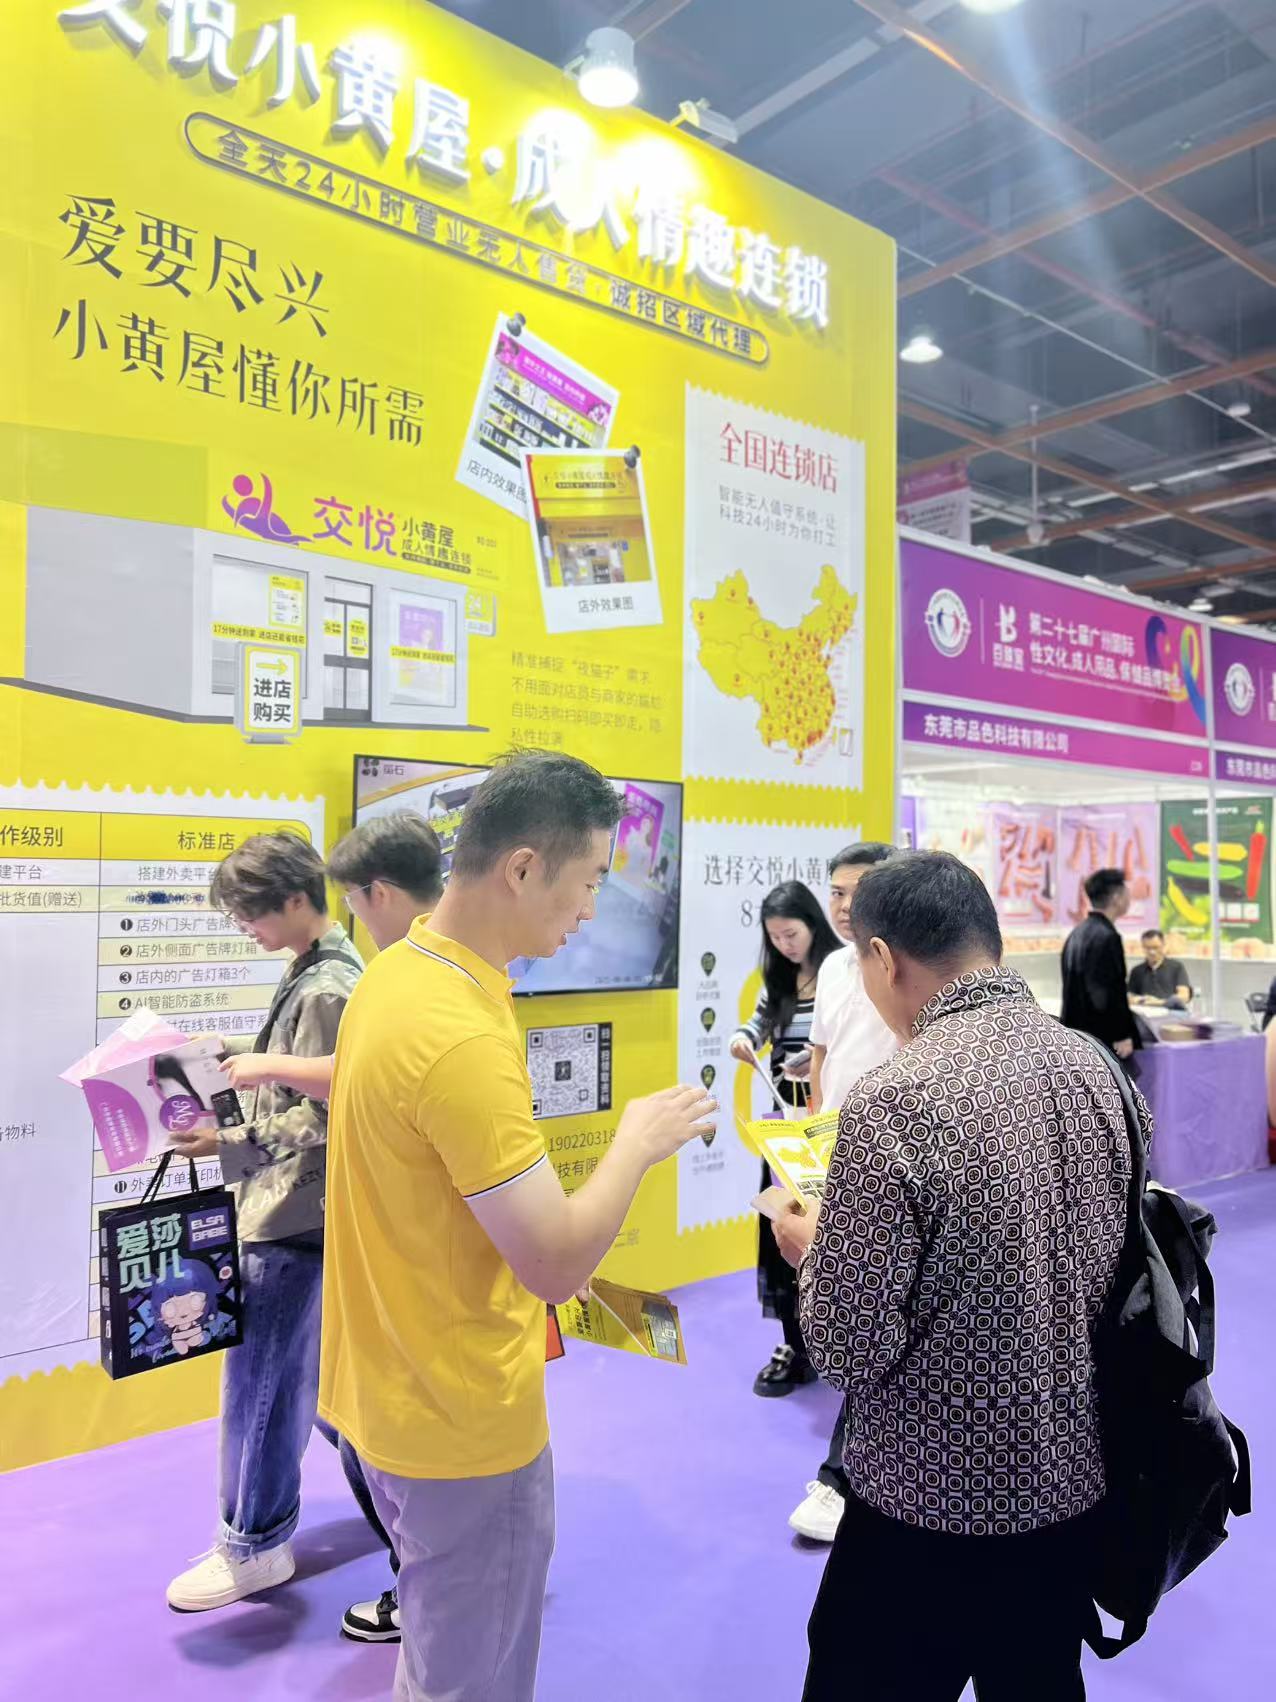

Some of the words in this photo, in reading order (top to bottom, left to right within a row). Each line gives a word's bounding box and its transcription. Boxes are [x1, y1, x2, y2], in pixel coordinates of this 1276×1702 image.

[58, 194, 330, 338] 爱要尽兴
[53, 299, 425, 447] 小黄屋懂你所需
[719, 421, 839, 494] 全国连锁店
[312, 496, 398, 557] 交悦
[402, 517, 455, 549] 小黄屋
[578, 596, 634, 613] 店外效果图
[254, 678, 291, 699] 进店
[253, 702, 291, 723] 购买
[924, 713, 1070, 754] 东莞市品色科技有限公司
[178, 831, 236, 851] 标准店
[703, 854, 834, 887] 选择交悦小黄
[740, 899, 762, 929] 8
[136, 942, 257, 958] 店外侧面广告牌灯箱
[136, 966, 250, 984] 店内的广告灯箱3个
[0, 1122, 36, 1142] 物料
[553, 1156, 599, 1179] 技有限
[191, 1214, 225, 1230] ELSA
[192, 1226, 229, 1243] BABE
[117, 1213, 182, 1259] 爱莎
[119, 1249, 185, 1294] 贝儿
